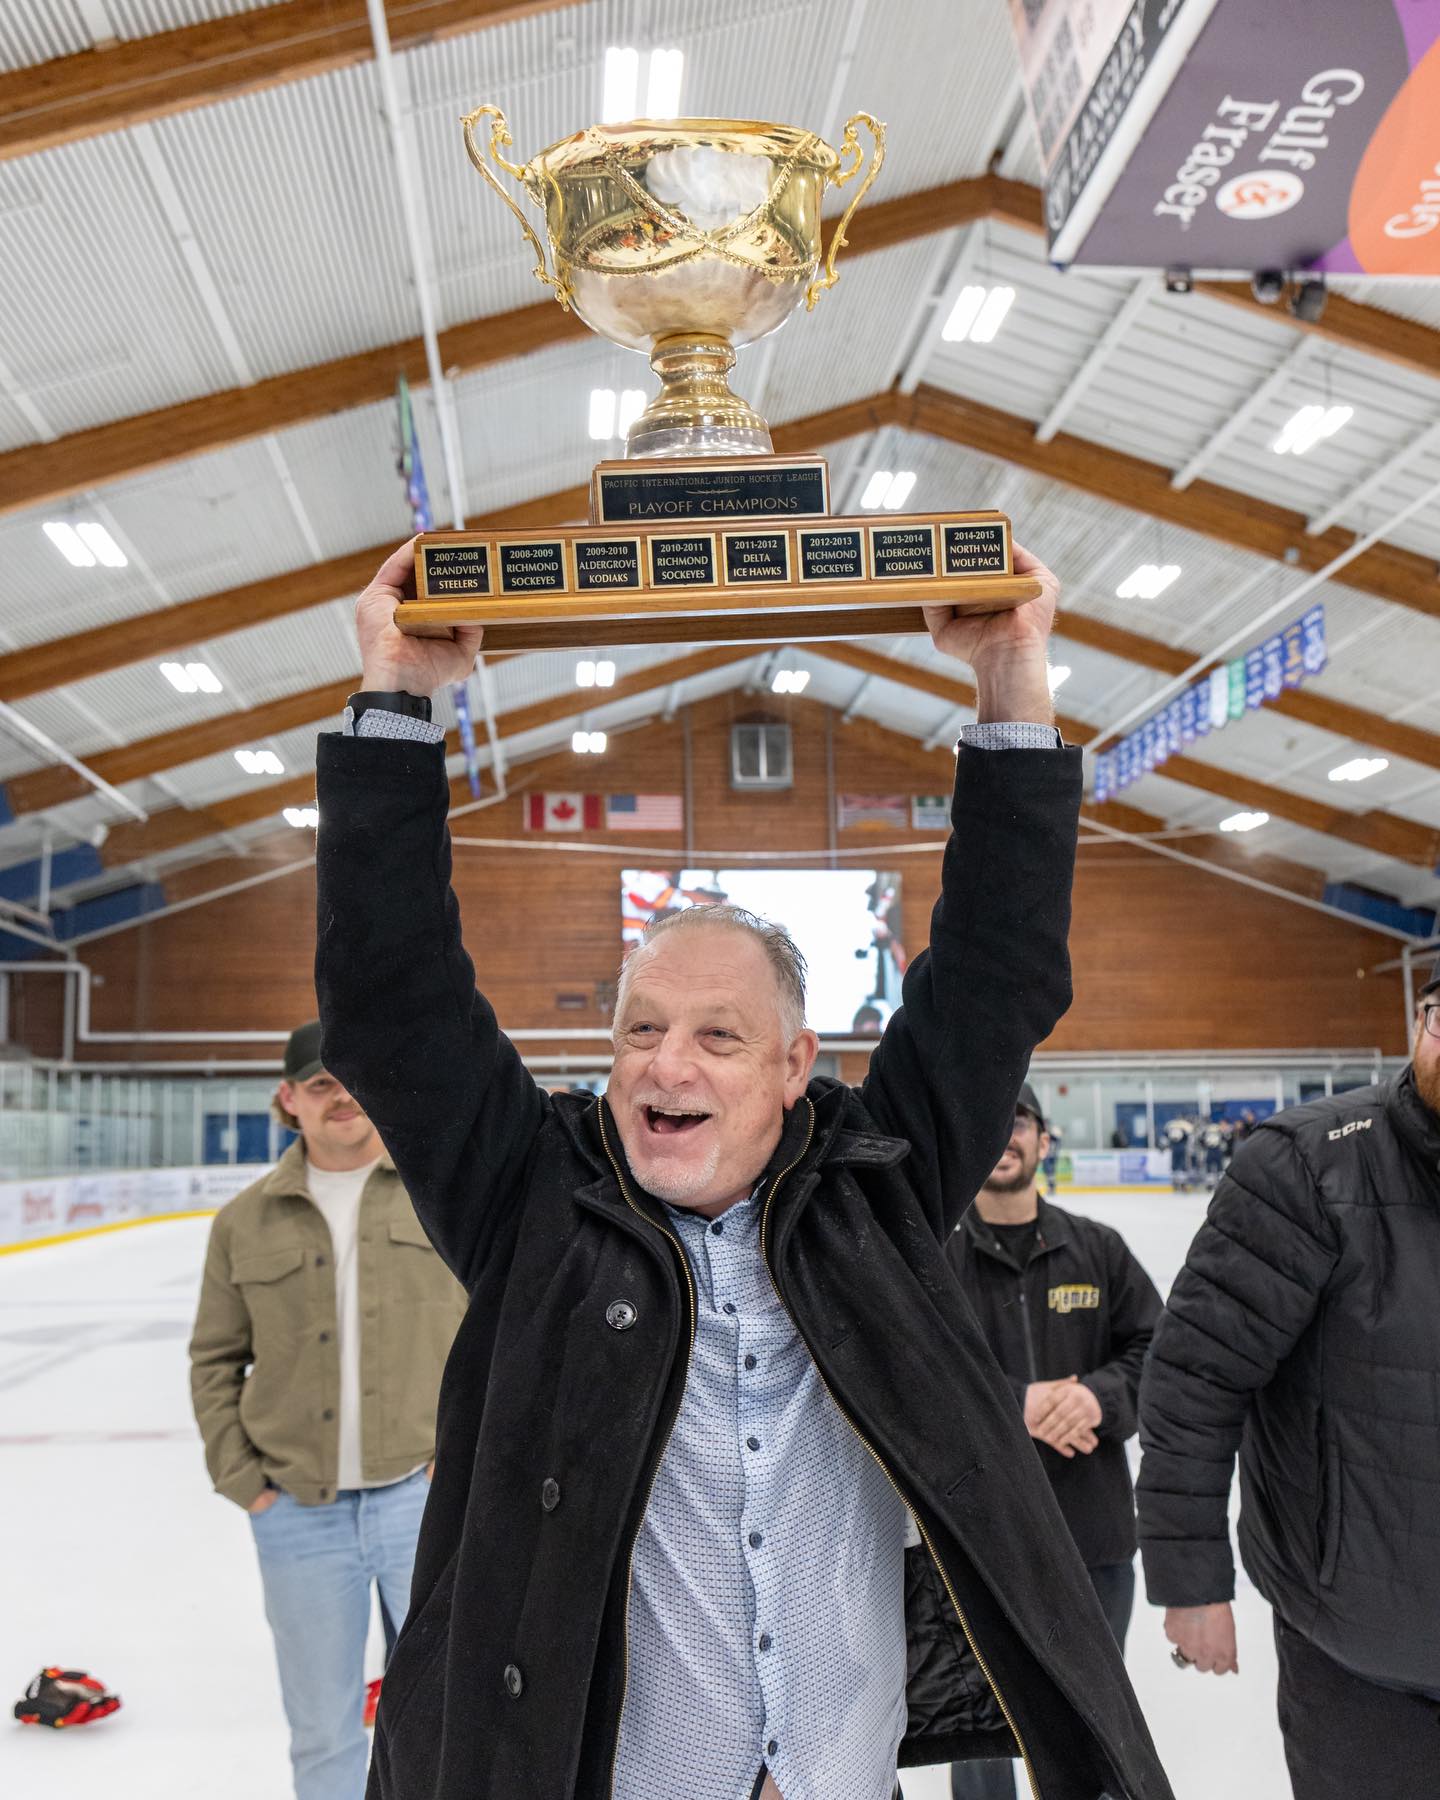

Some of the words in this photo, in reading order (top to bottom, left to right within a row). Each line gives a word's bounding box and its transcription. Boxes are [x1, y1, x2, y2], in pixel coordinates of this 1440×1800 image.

[1258, 68, 1365, 171] Gulf
[1153, 94, 1280, 224] Fraser
[604, 480, 638, 489] PACIFIC
[642, 477, 710, 488] INTERNATIONAL
[713, 475, 745, 484] JUNIOR
[749, 474, 783, 483] HOCKEY
[786, 472, 819, 482] LEAGUE
[629, 501, 693, 515] PLAYOFF
[701, 497, 798, 512] CHAMPIONS
[882, 534, 923, 545] 2013-2014
[954, 530, 995, 541] 2014-2015
[660, 543, 703, 553] 2010-2011
[734, 539, 777, 550] 2011-2012
[810, 537, 852, 547] 2012-2013
[510, 548, 553, 559] 2008-2009
[585, 546, 628, 556] 2009-2010
[806, 549, 857, 561] RICHMOND
[875, 547, 932, 559] ALDERGROVE
[950, 545, 981, 555] NORTH
[982, 543, 1000, 553] VAN
[434, 552, 479, 562] 2007-2008
[657, 555, 708, 567] RICHMOND
[743, 553, 771, 563] DELTA
[951, 557, 976, 567] WOLF
[977, 555, 1000, 566] PACK
[506, 561, 559, 573] RICHMOND
[579, 558, 637, 570] ALDERGROVE
[811, 563, 854, 574] SOCKEYES
[885, 560, 924, 572] KODIAKS
[429, 564, 486, 577] GRANDVIEW
[661, 569, 705, 580] SOCKEYES
[733, 567, 748, 577] ICE
[749, 566, 782, 577] HAWKS
[439, 578, 478, 590] STEELERS
[511, 575, 556, 587] SOCKEYES
[589, 573, 629, 584] KODIAKS
[1328, 1118, 1372, 1141] CCM
